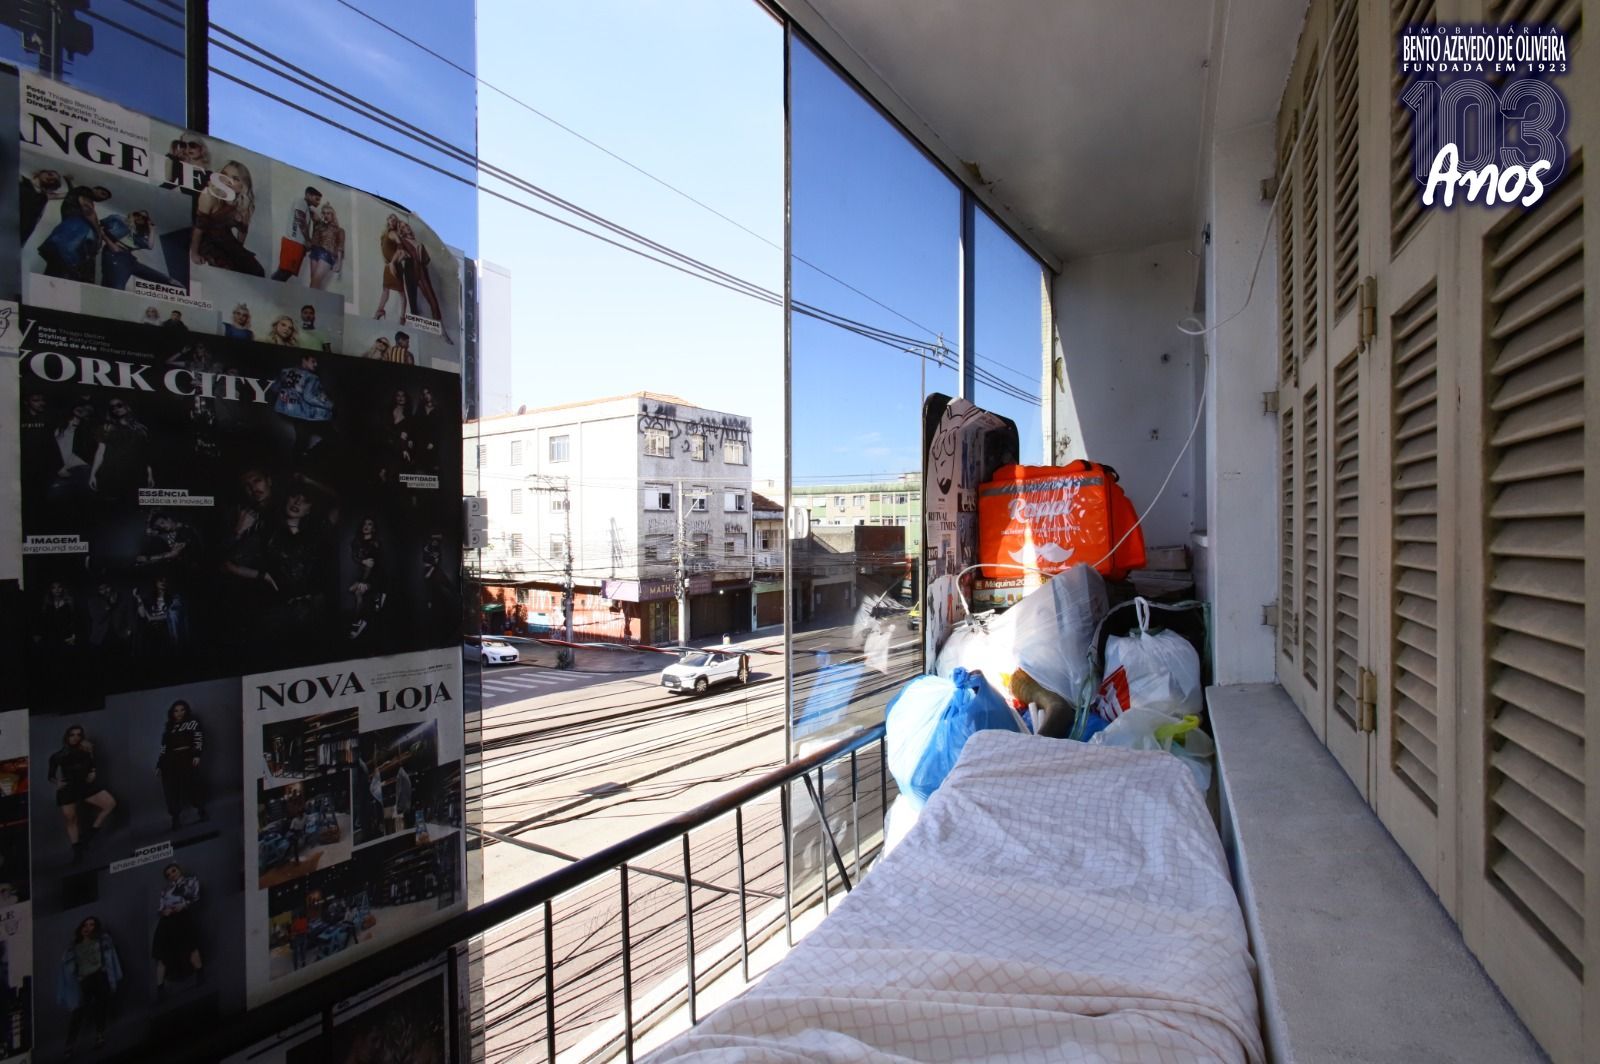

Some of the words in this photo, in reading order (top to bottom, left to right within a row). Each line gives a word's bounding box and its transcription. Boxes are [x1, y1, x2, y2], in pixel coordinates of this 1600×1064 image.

[26, 92, 57, 106] Styling
[26, 98, 59, 113] Direção
[71, 113, 89, 123] Arte
[135, 281, 185, 297] ESSÊNCIA
[37, 338, 69, 349] Direção
[163, 366, 276, 404] CITY
[139, 489, 188, 498] ESSÊNCIA
[1008, 497, 1072, 524] Rappi
[31, 537, 78, 545] IMAGEM
[256, 671, 365, 711] NOVA
[377, 681, 452, 714] LOJA
